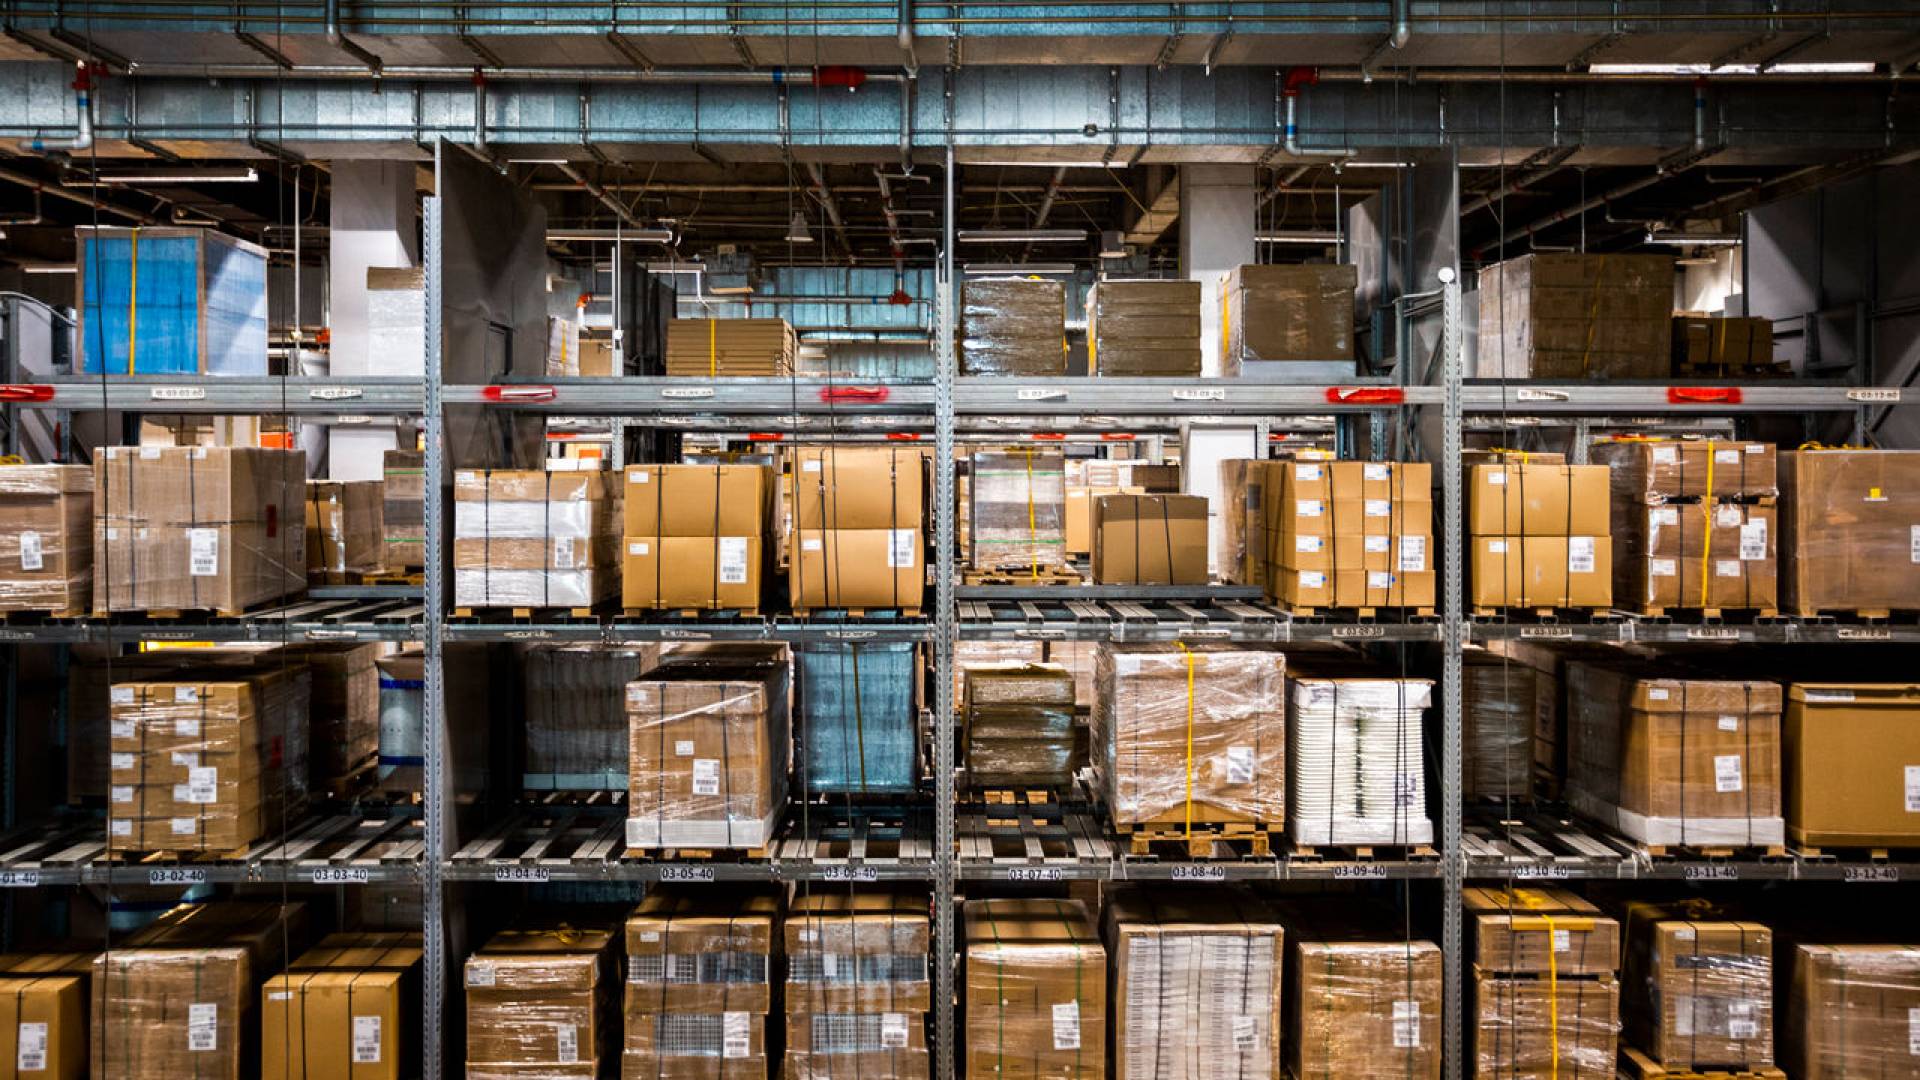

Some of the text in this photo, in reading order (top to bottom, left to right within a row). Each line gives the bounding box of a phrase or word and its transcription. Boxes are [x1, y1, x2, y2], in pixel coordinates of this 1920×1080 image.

[151, 871, 204, 881] 03-02-40
[314, 869, 367, 880] 03-03-40
[496, 867, 549, 879] 03-04-40
[662, 868, 713, 879] 03-05-40
[1009, 869, 1061, 880] 03-07-40
[1173, 866, 1223, 877] 03-08-40
[1334, 866, 1386, 877] 03-09-40
[1686, 867, 1737, 877] 03-11-40
[1845, 868, 1897, 879] 03-12-40
